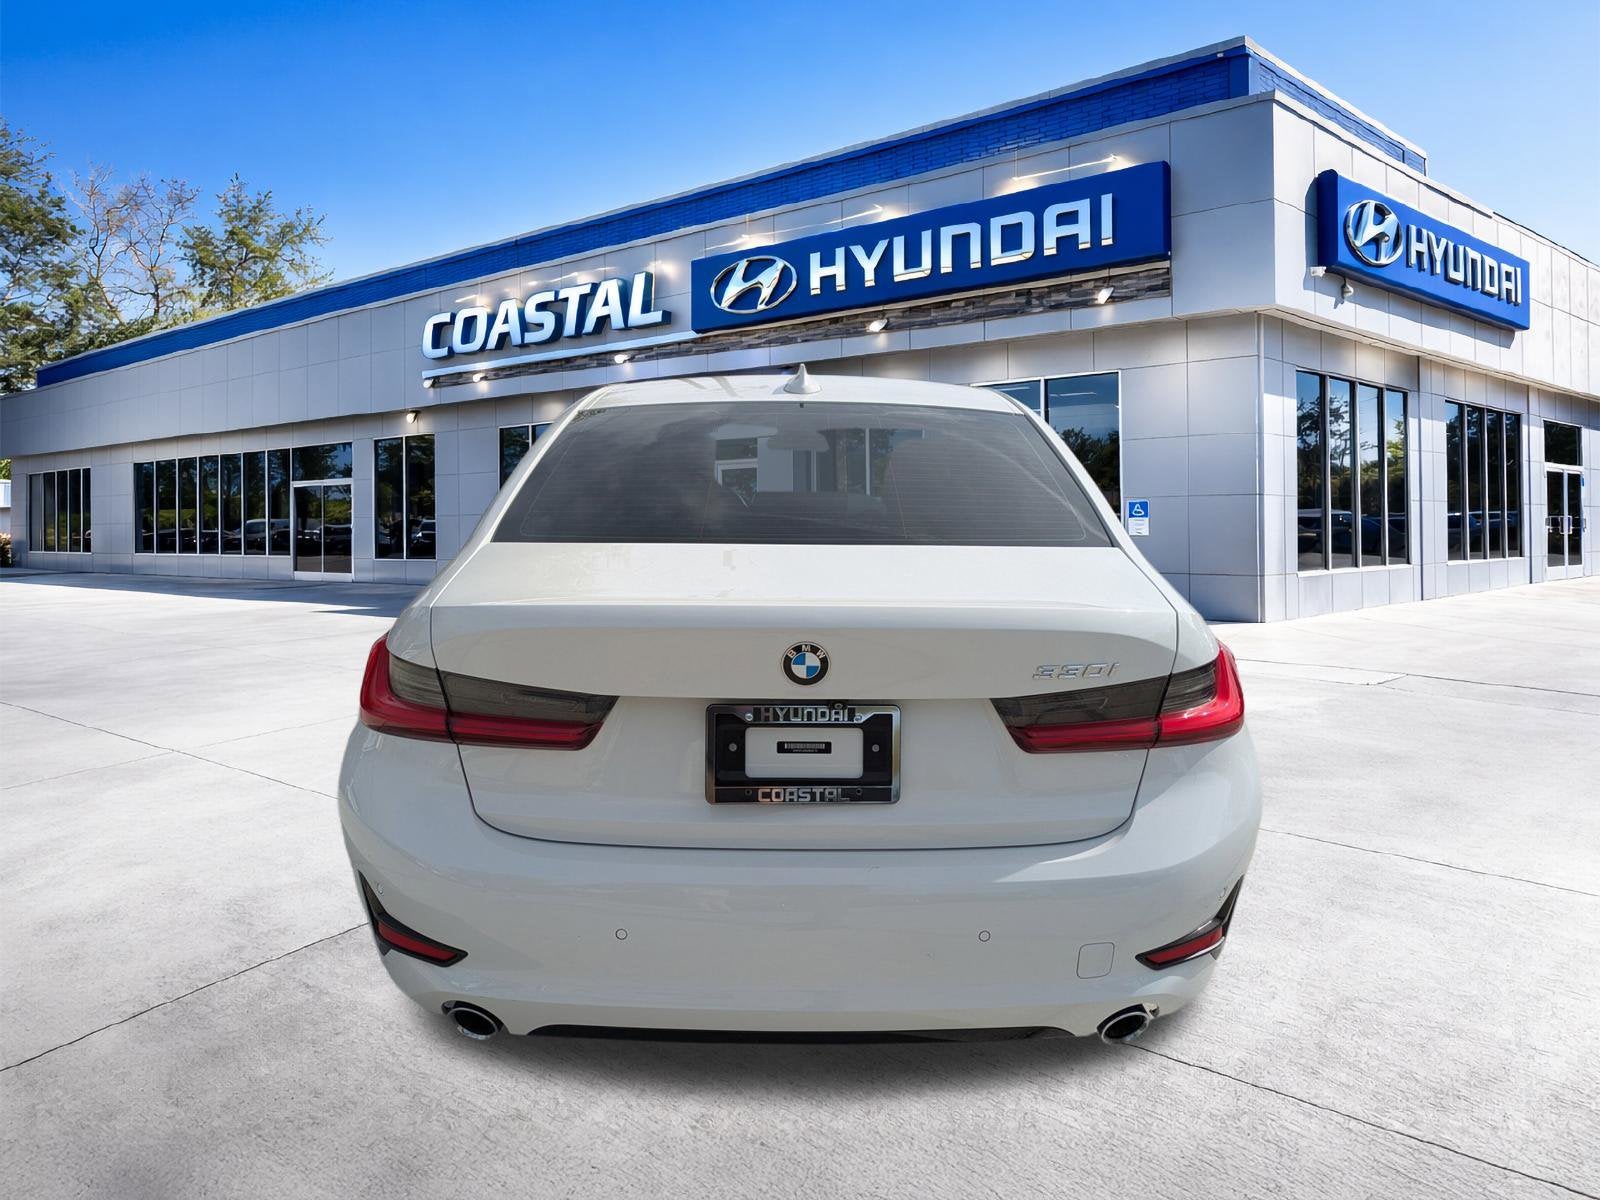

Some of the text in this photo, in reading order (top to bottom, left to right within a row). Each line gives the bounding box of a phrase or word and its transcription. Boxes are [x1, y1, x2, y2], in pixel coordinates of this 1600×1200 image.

[810, 193, 1113, 296] HYUNDAI
[1406, 224, 1522, 306] HYUNDAI
[422, 271, 668, 360] COASTAL
[787, 644, 826, 659] BMW
[1032, 662, 1120, 679] 330i
[760, 706, 849, 722] HYUNDAI
[758, 788, 850, 802] COASTAL
